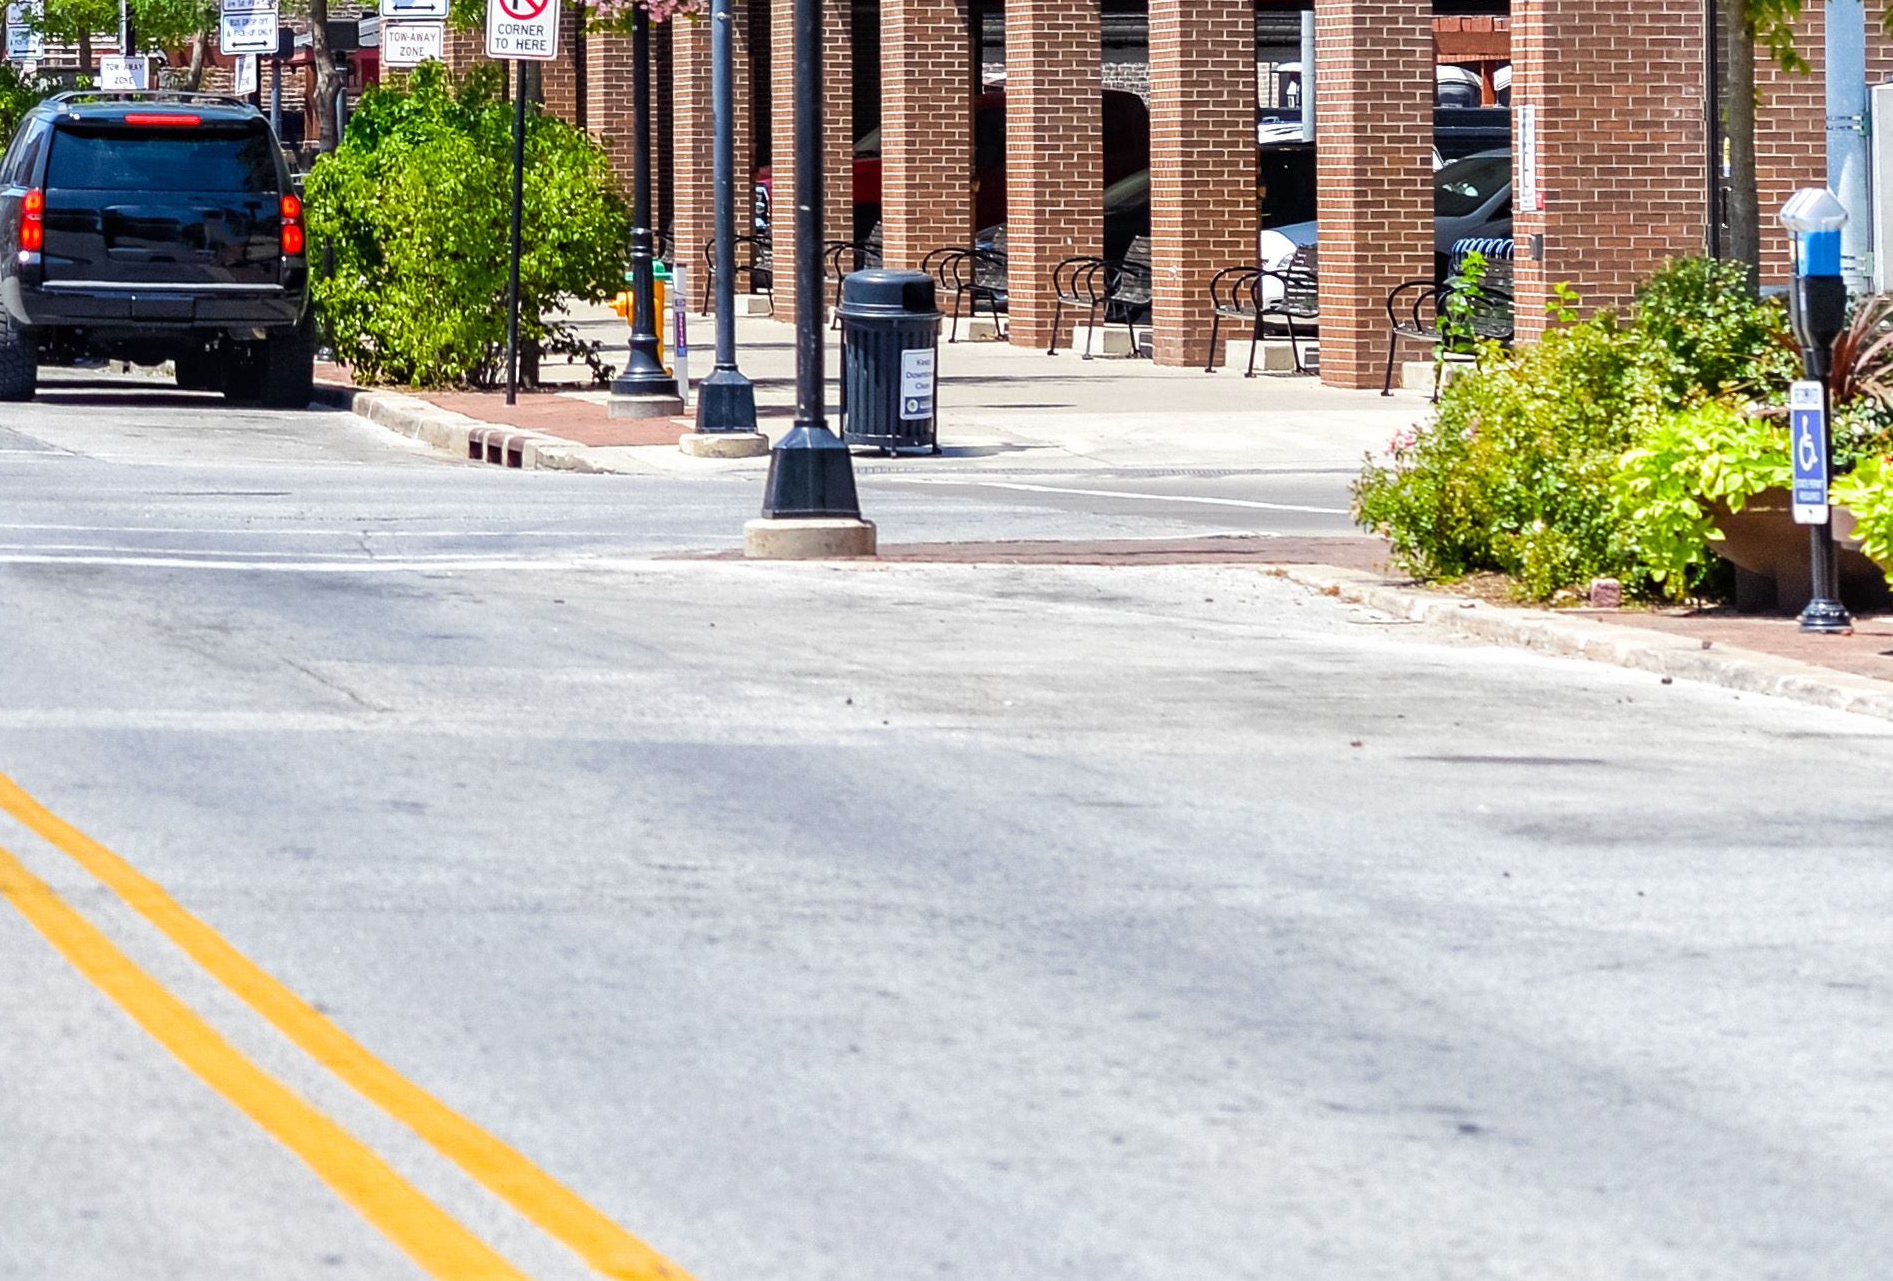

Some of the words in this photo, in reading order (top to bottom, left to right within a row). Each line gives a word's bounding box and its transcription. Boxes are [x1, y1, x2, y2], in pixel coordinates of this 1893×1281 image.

[497, 23, 545, 36] CORNER
[389, 32, 437, 42] TOW-AWAY
[495, 37, 509, 49] TO
[516, 38, 547, 51] HERE
[399, 46, 425, 57] ZONE
